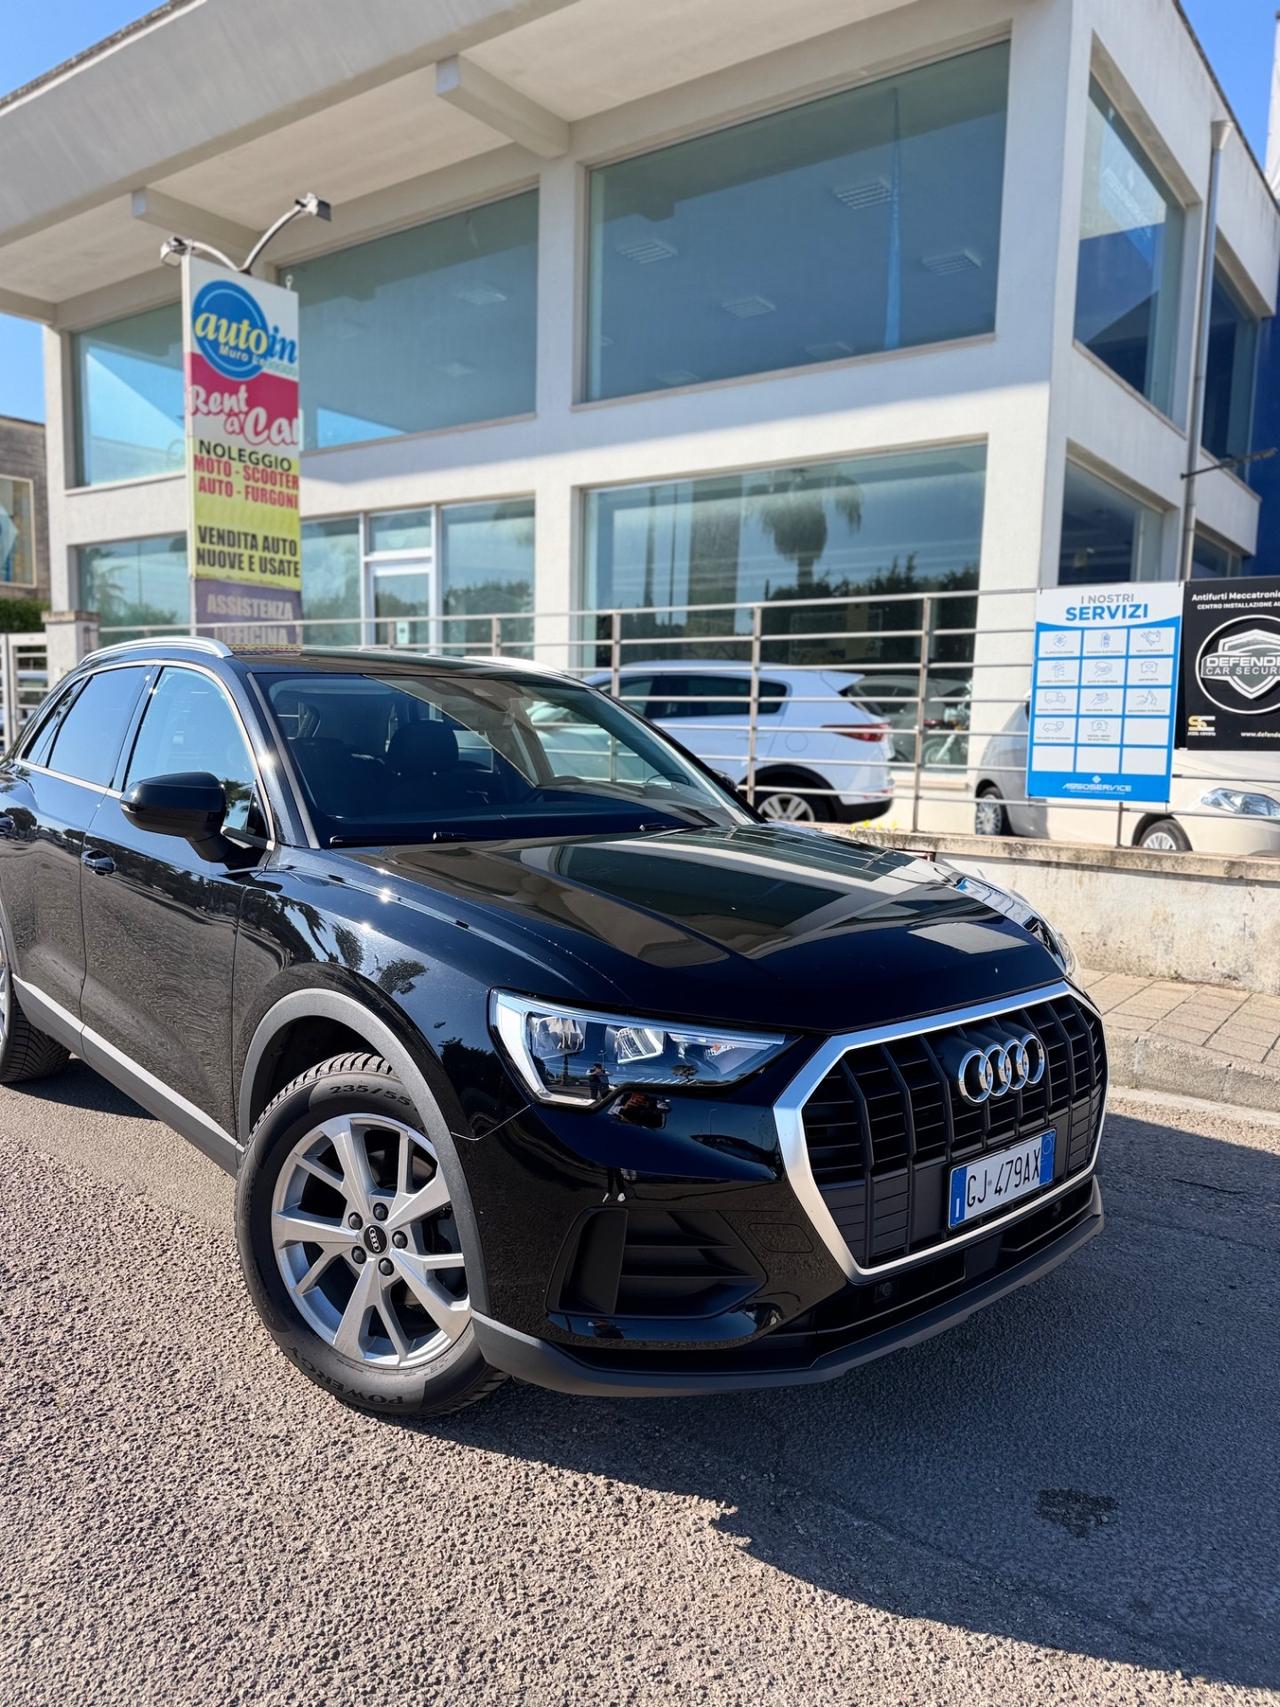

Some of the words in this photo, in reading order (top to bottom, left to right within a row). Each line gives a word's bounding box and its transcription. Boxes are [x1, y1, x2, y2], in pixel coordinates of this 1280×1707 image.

[189, 384, 249, 416] Rent
[198, 439, 292, 472] NOLEGGIO
[193, 454, 232, 478] MOTO
[242, 465, 300, 490] SCOOTER
[198, 476, 233, 497] AUTO
[244, 486, 299, 510] FURGONI
[197, 525, 258, 551] VENDITA
[262, 536, 297, 556] AUTO
[196, 547, 244, 571] NUOVE
[248, 554, 255, 572] E
[259, 557, 300, 578] USATE
[207, 593, 293, 620] ASSISTENZA
[1065, 603, 1149, 622] SERVIZI
[1088, 593, 1135, 604] NOSTRI
[1191, 592, 1228, 602] Antifurti
[1223, 601, 1273, 609] INSTALLAZIONE
[1206, 667, 1231, 675] CAR
[967, 1169, 988, 1208] GJ
[994, 1147, 1041, 1196] 479AX
